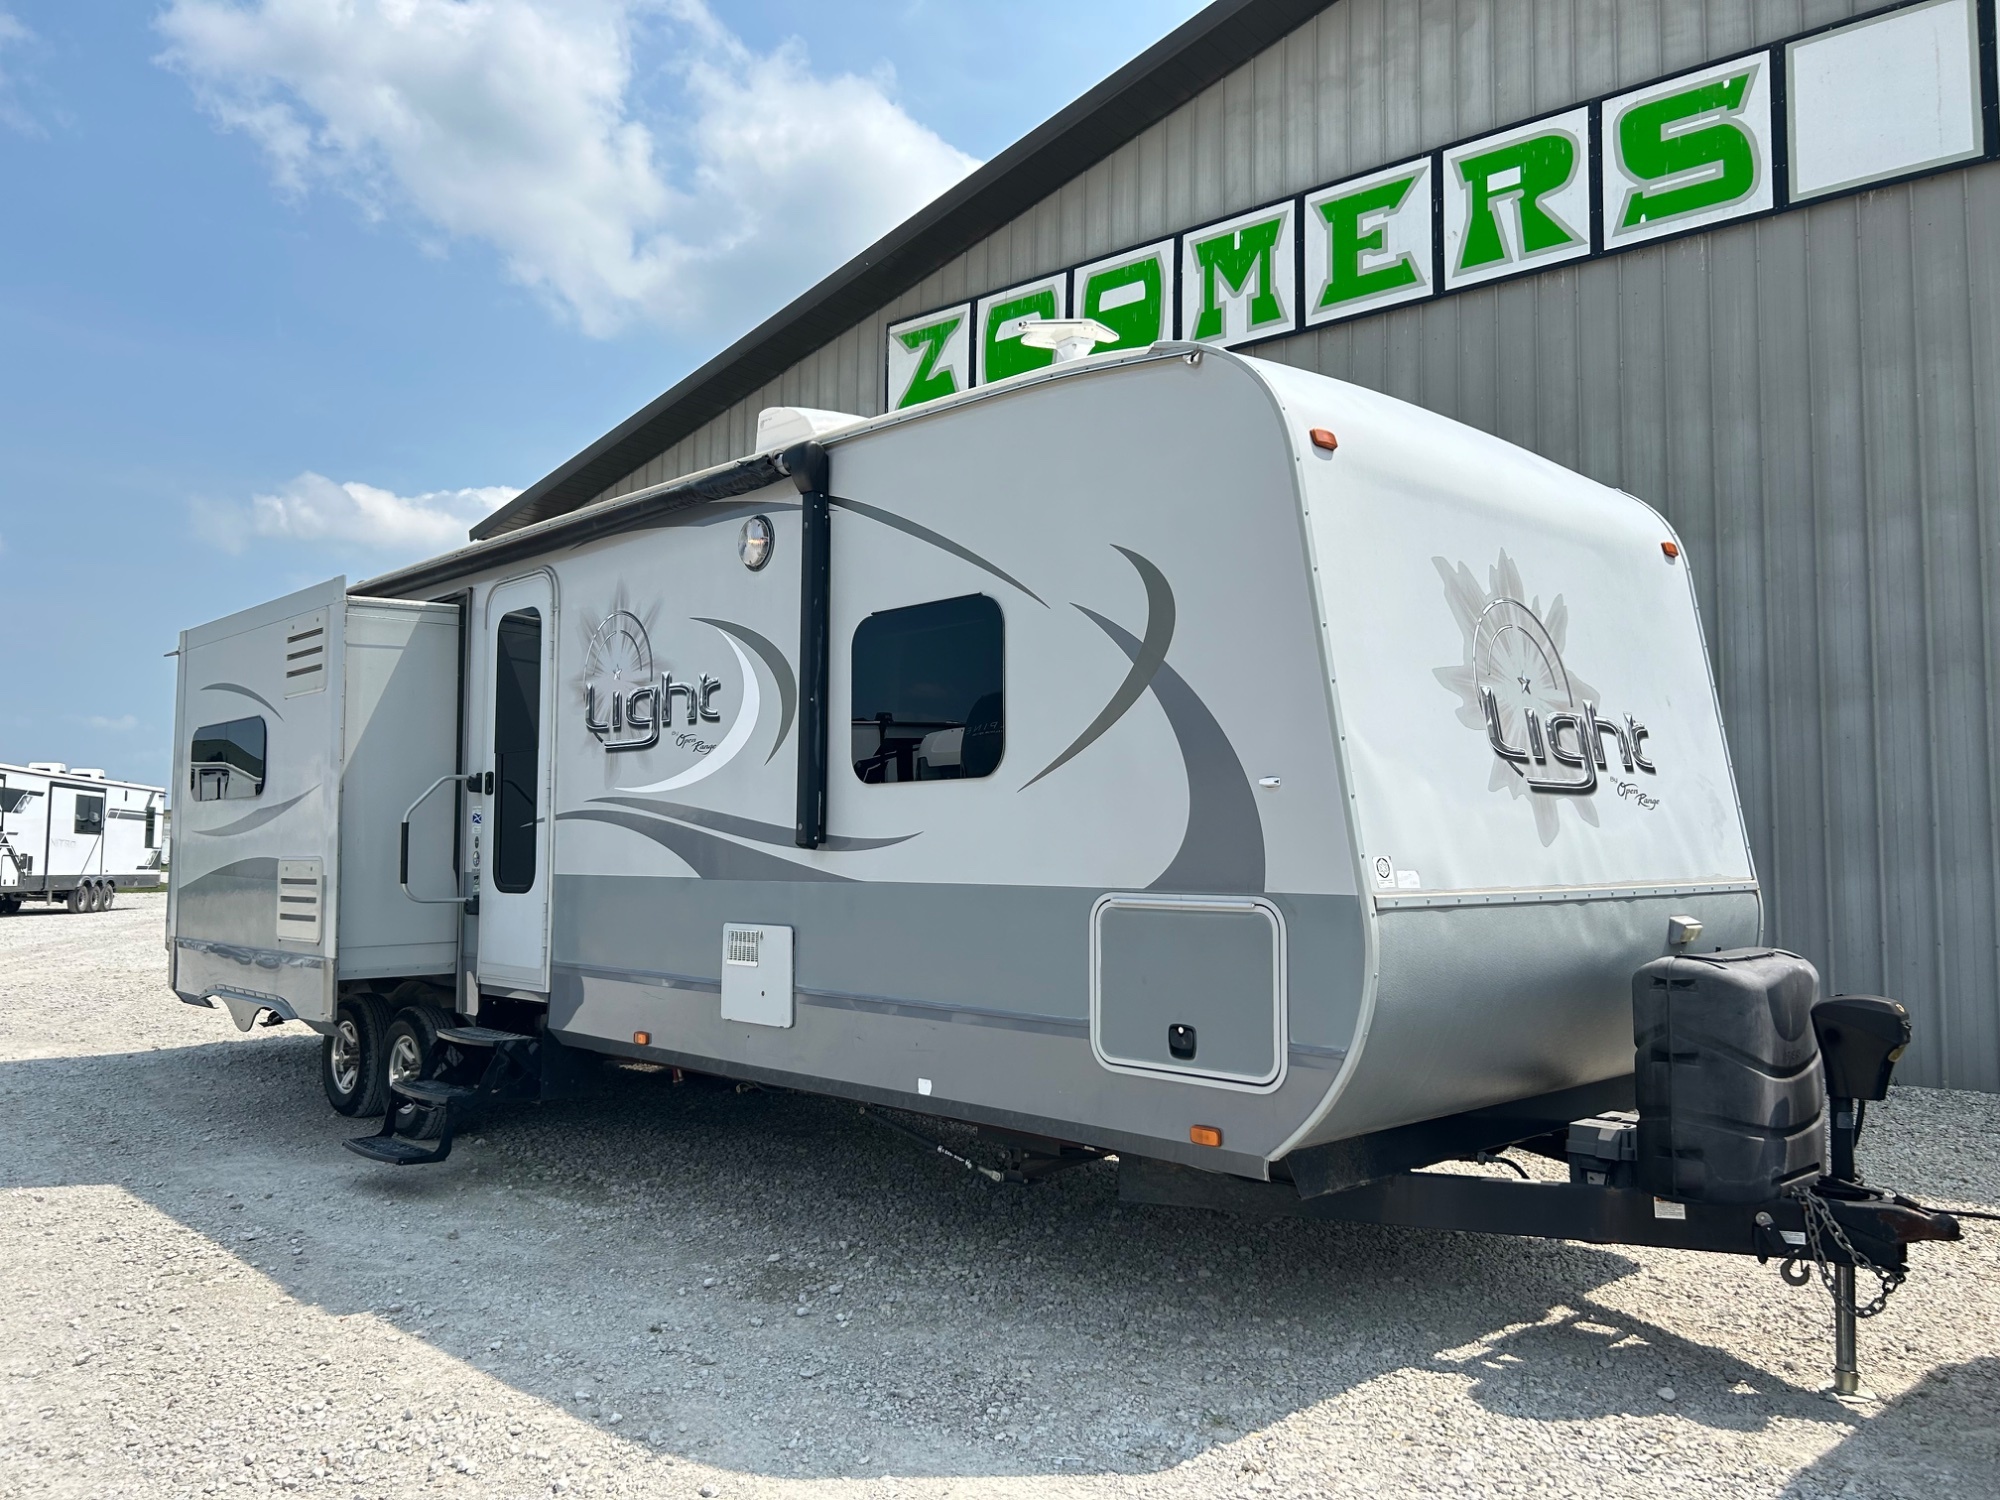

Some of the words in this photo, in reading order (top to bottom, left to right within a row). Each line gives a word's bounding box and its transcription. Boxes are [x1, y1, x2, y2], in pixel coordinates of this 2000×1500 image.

[891, 65, 1761, 411] ZOOMERS
[585, 670, 721, 754] Light
[676, 733, 697, 749] Open
[691, 740, 717, 755] Range
[1480, 686, 1657, 795] Light
[1617, 781, 1639, 800] Open
[1634, 793, 1660, 810] Range
